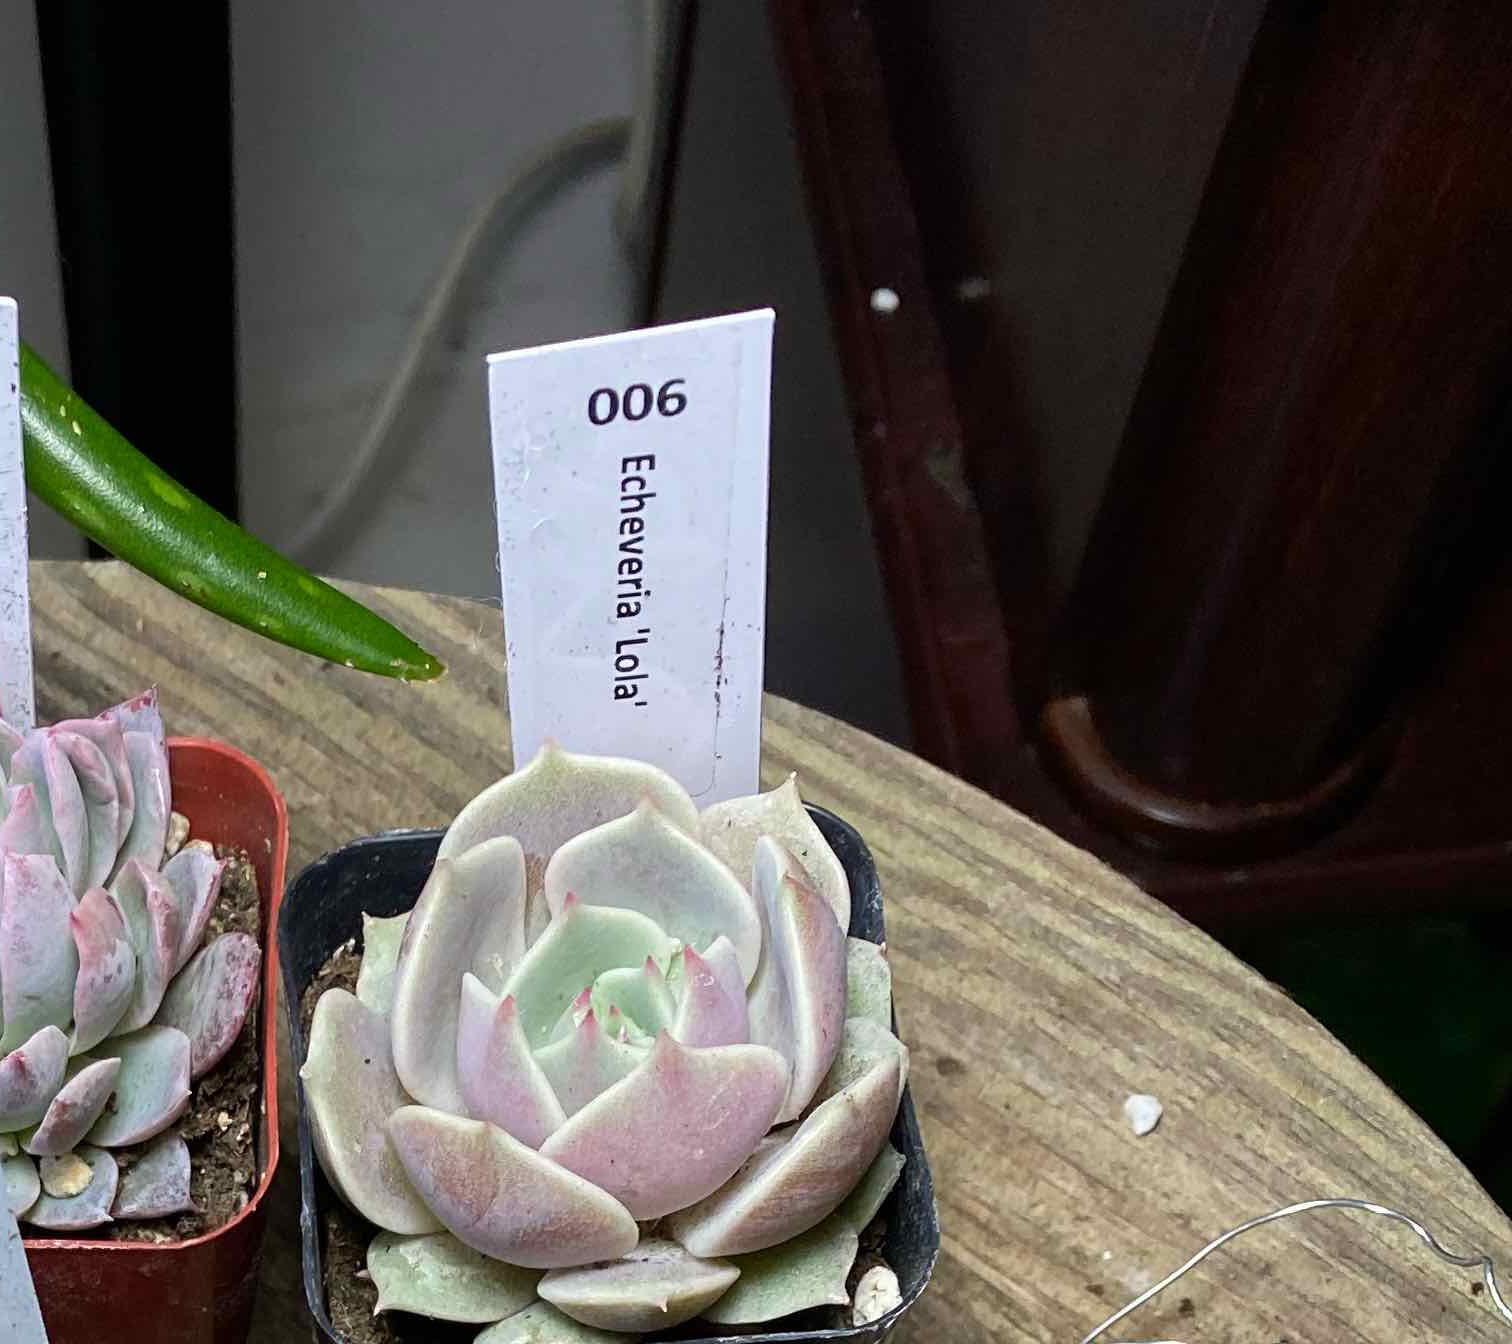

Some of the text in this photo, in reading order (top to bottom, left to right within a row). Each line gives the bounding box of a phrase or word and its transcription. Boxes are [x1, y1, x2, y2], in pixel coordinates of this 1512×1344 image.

[588, 378, 688, 426] 006
[614, 454, 657, 708] Echeveria 'Lola'
